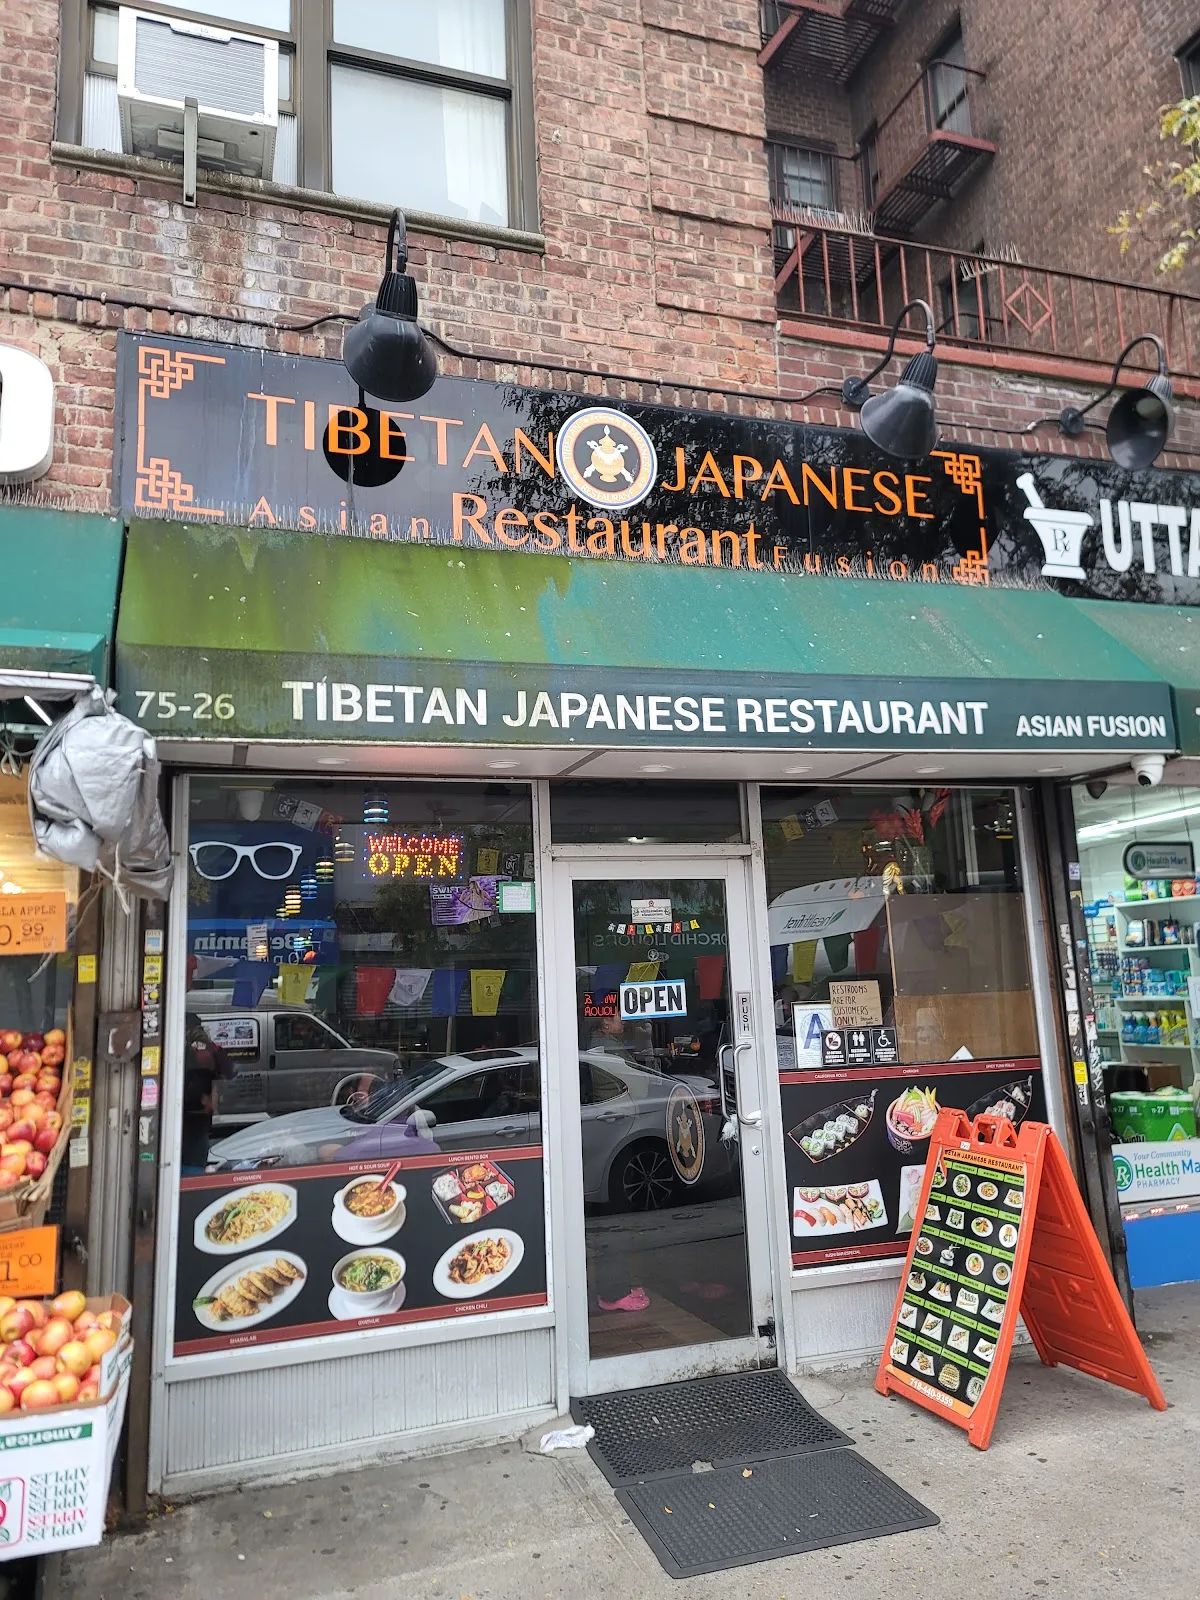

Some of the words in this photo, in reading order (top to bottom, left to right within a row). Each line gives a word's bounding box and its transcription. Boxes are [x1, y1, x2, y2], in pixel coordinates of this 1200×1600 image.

[247, 392, 556, 479] TIBETAN
[662, 447, 935, 519] JAPANESE
[249, 495, 431, 540] Asian
[452, 492, 763, 570] Restaurant
[773, 545, 939, 582] Fusion
[134, 689, 236, 720] 75-26
[281, 678, 489, 727] TIBETAN
[502, 690, 727, 733] JAPANESE
[738, 697, 989, 736] RESTAURANT
[1016, 714, 1083, 737] ASIAN
[1086, 715, 1167, 738] FUSION
[368, 835, 460, 854] WELCOME
[368, 852, 459, 875] OPEN
[20, 905, 56, 916] APPLE
[831, 985, 868, 995] RESTROOMS
[624, 985, 683, 1015] OPEN
[833, 996, 844, 1005] ARE
[845, 996, 857, 1005] FOR
[741, 997, 750, 1031] PUSH
[833, 1005, 869, 1016] CUSTOMERS
[803, 1013, 825, 1050] A
[961, 1152, 987, 1164] JAPANESE
[988, 1158, 1023, 1172] RESTAURANT
[1133, 1152, 1150, 1161] Your
[1150, 1148, 1191, 1160] Community
[1135, 1160, 1180, 1179] Health
[1136, 1177, 1180, 1188] PHARMACY
[910, 1377, 954, 1407] 718-440-9359
[30, 1466, 89, 1484] APPLES
[29, 1481, 88, 1499] APPLES
[28, 1495, 88, 1513] APPLES
[28, 1508, 87, 1527] APPLES
[26, 1521, 87, 1542] APPLES
